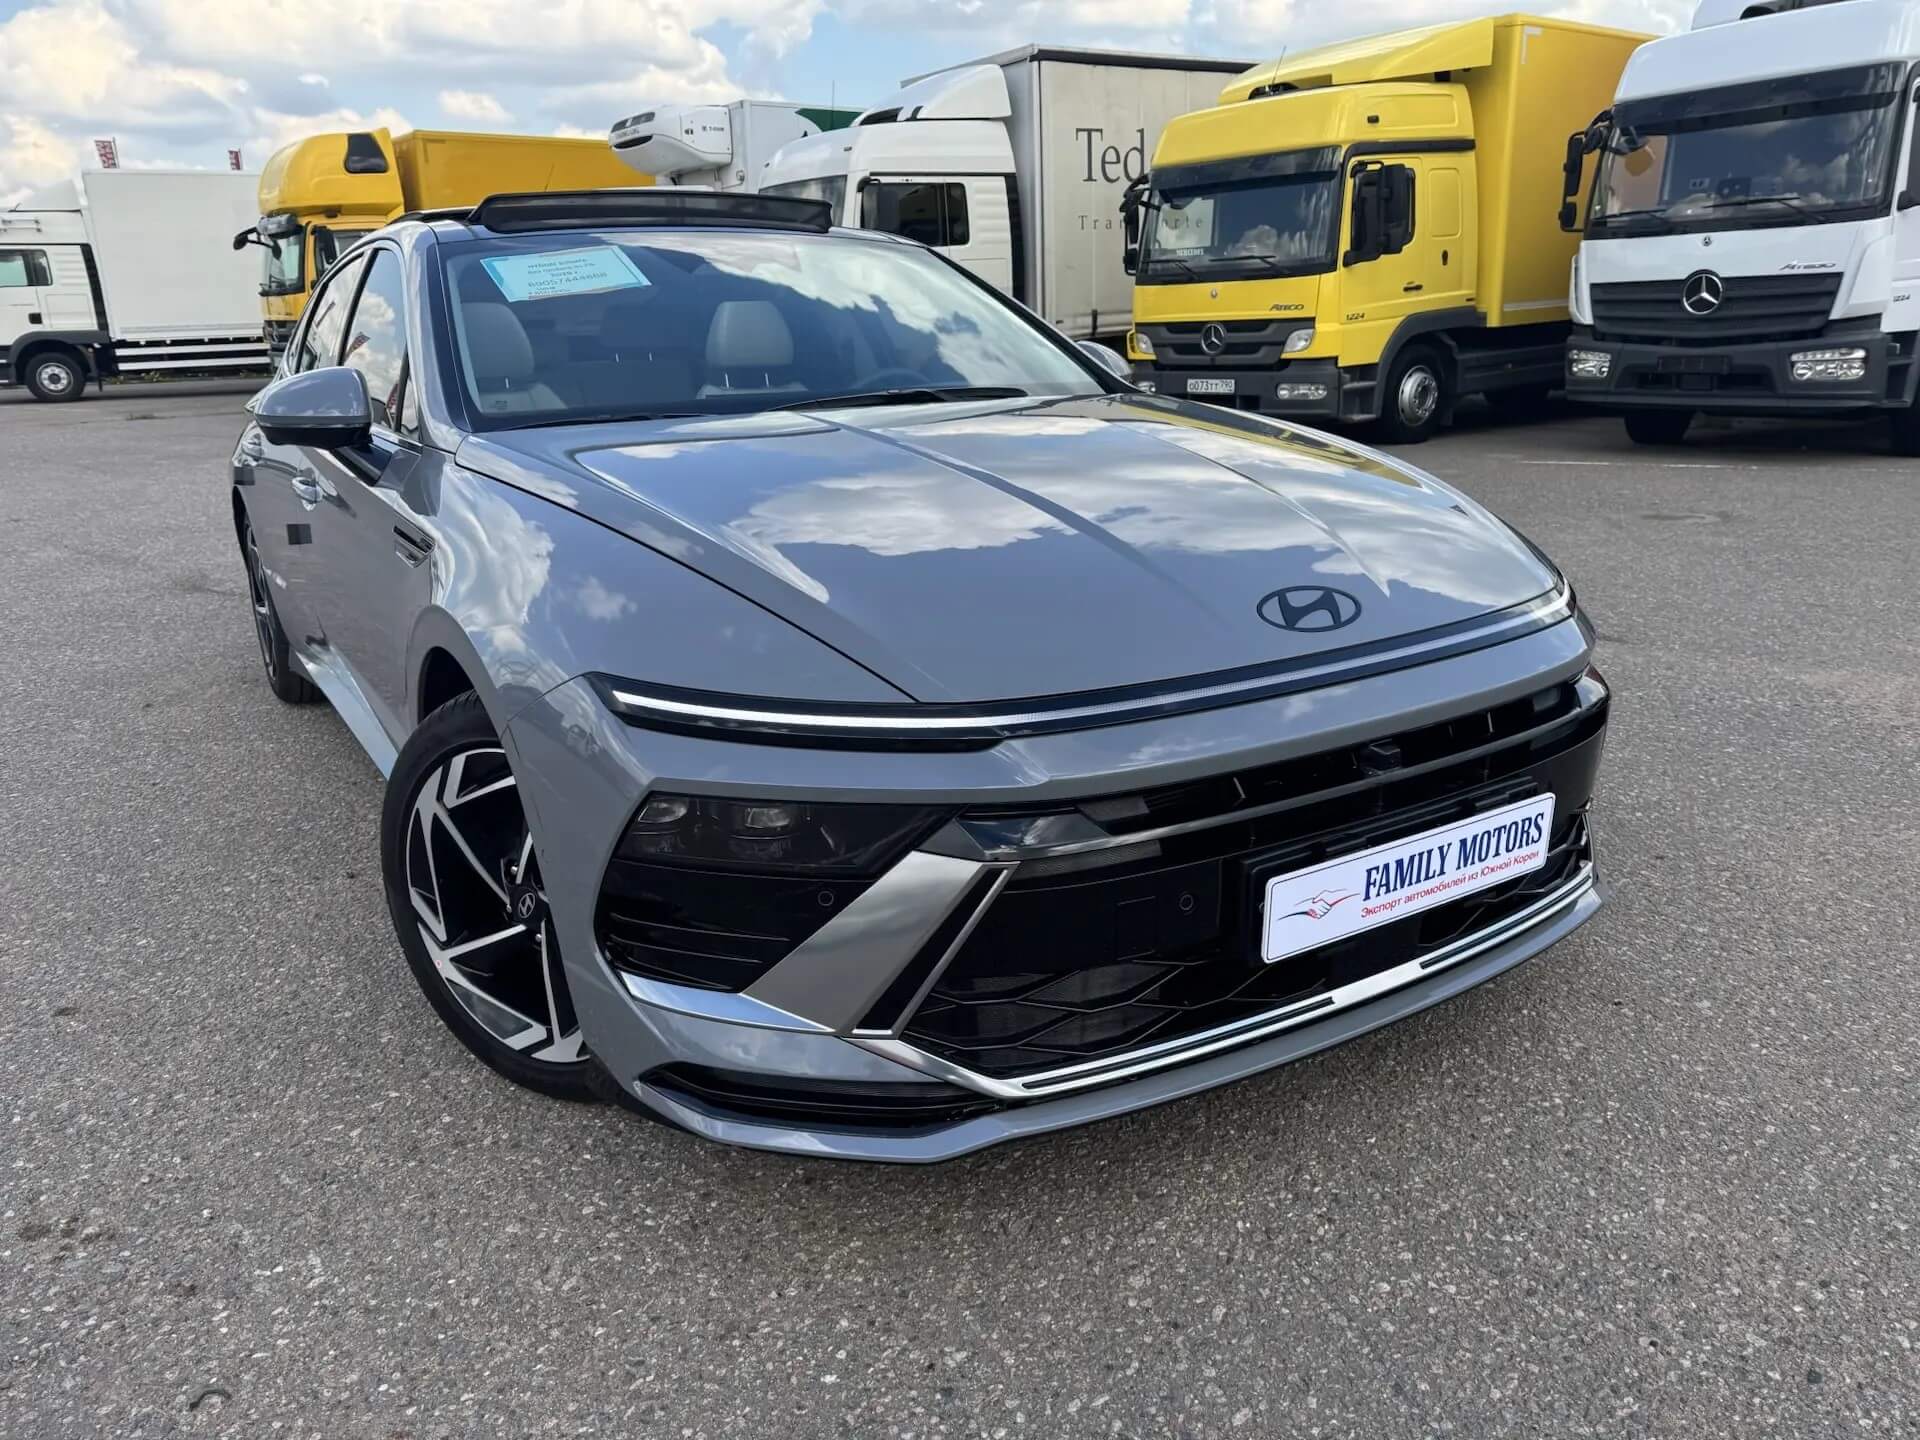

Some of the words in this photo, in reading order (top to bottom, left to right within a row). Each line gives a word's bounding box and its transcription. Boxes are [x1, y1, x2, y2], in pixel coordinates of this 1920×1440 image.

[1075, 127, 1154, 184] Ted
[1362, 841, 1453, 902] FAMILY
[1455, 811, 1545, 872] MOTORS
[1360, 896, 1403, 918] Экспорт
[1403, 874, 1467, 905] автомобилей
[1467, 872, 1479, 883] из
[1480, 859, 1513, 877] Южной
